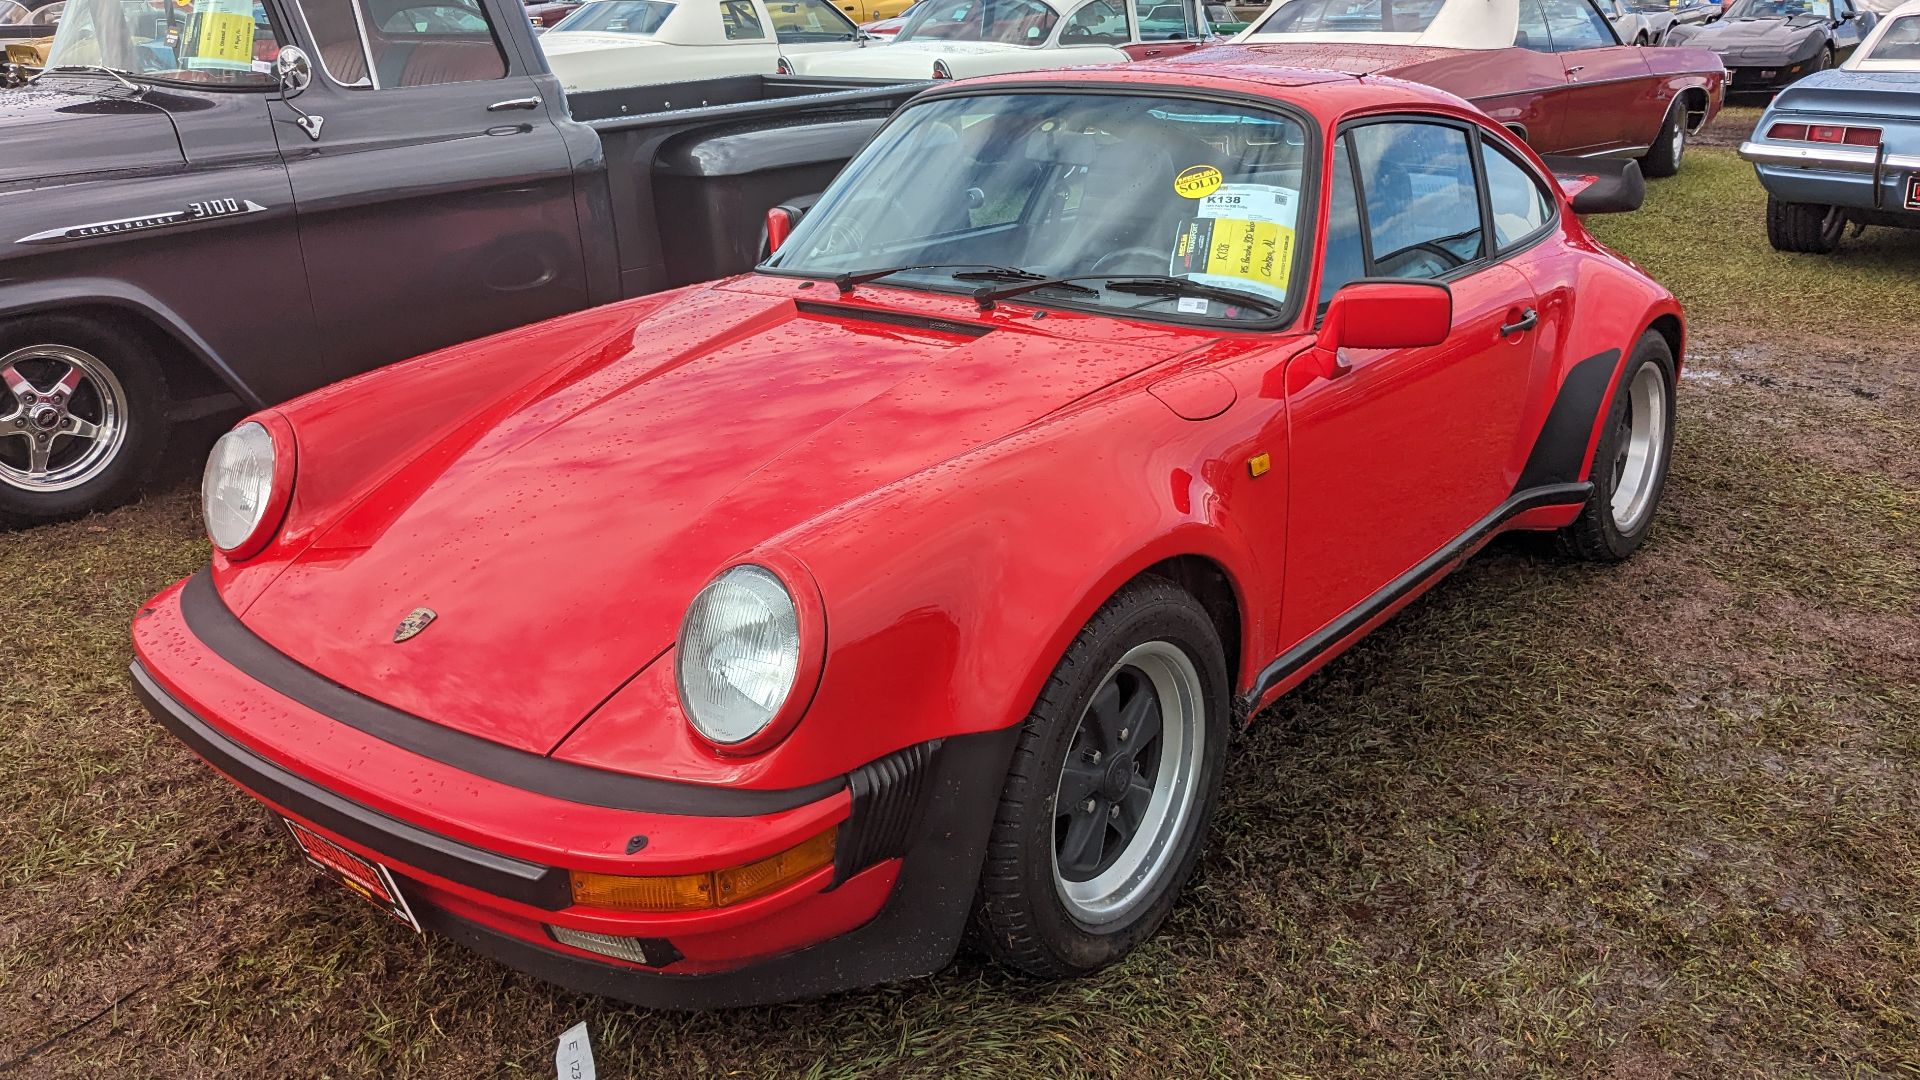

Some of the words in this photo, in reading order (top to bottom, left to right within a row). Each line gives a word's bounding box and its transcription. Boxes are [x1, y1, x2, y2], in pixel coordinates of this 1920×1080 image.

[1176, 169, 1219, 185] MECUM
[1180, 176, 1220, 193] SOLD
[189, 197, 239, 218] 3100
[1207, 196, 1241, 204] K138
[79, 216, 174, 236] CHEVROLET
[1216, 243, 1229, 261] K138
[569, 1040, 578, 1051] E
